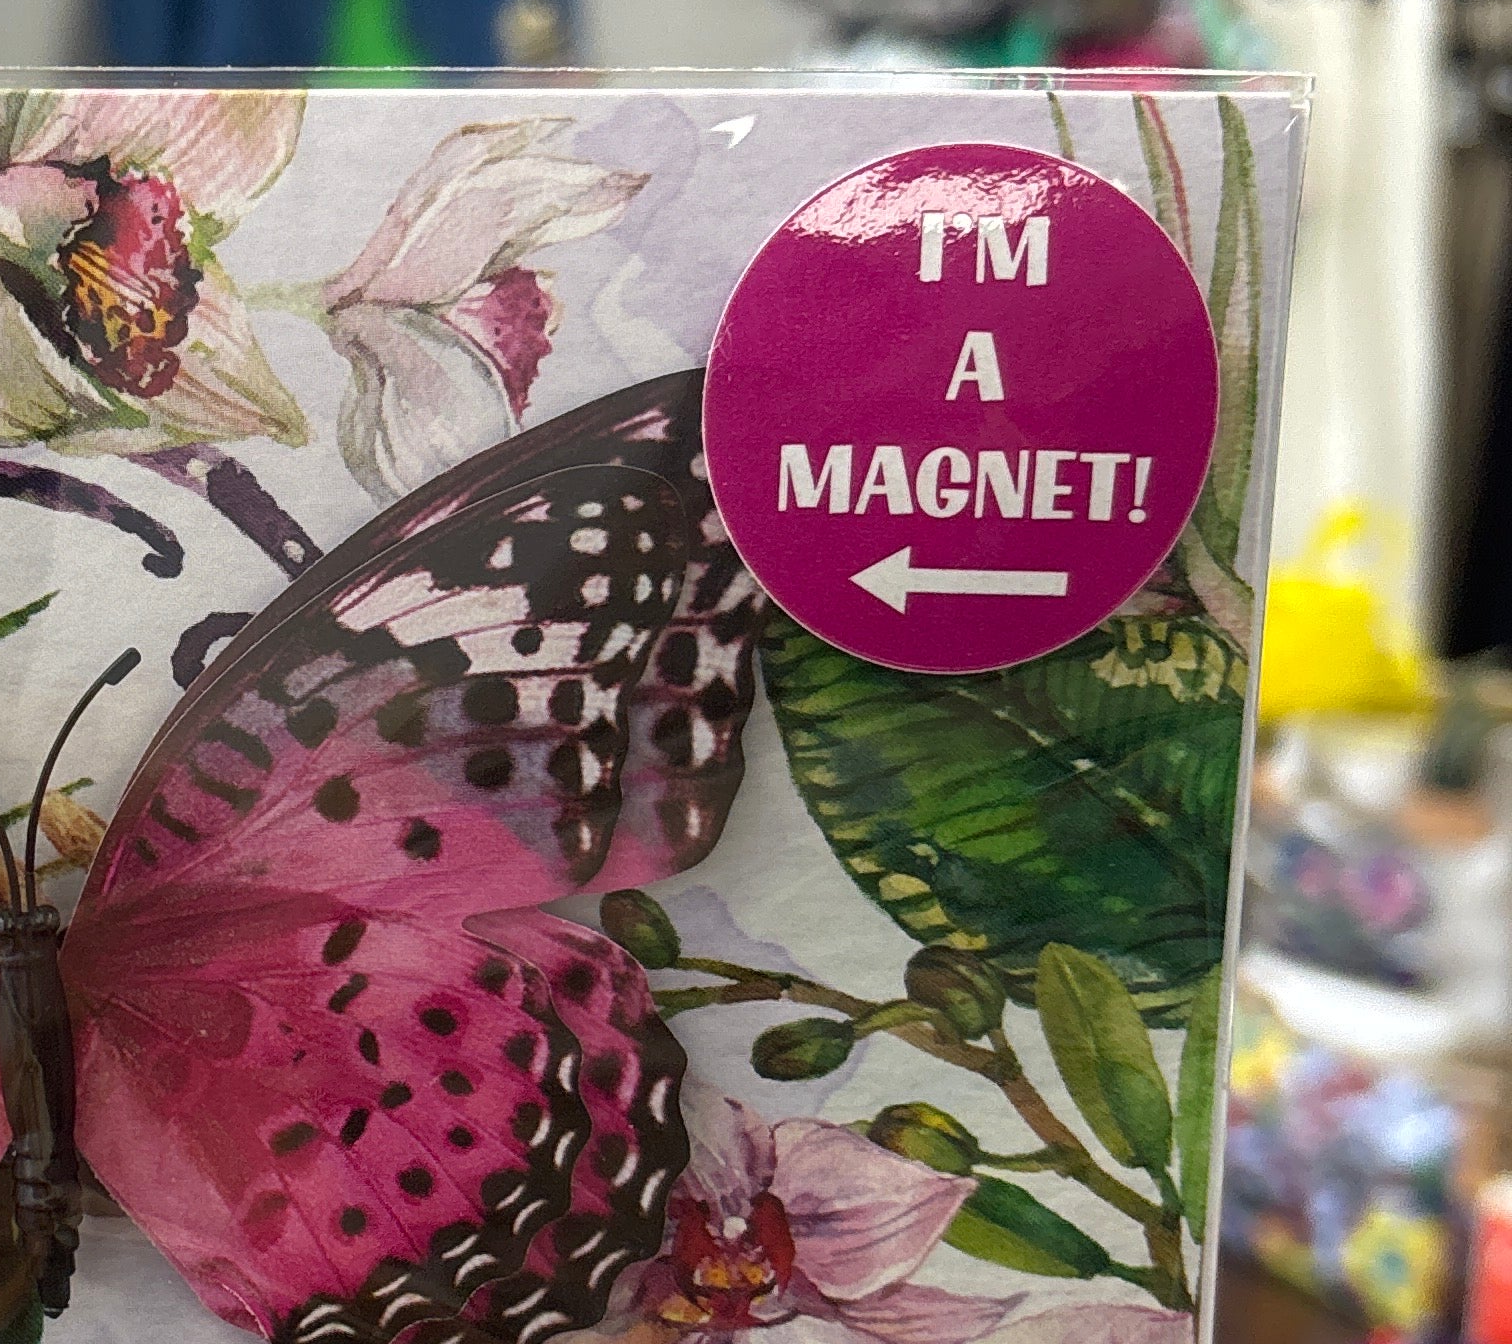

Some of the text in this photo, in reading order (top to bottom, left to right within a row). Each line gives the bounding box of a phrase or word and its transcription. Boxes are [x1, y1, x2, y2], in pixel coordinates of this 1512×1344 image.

[917, 210, 1050, 286] I'M
[945, 331, 1005, 401] A
[777, 443, 1153, 524] MAGNET!
